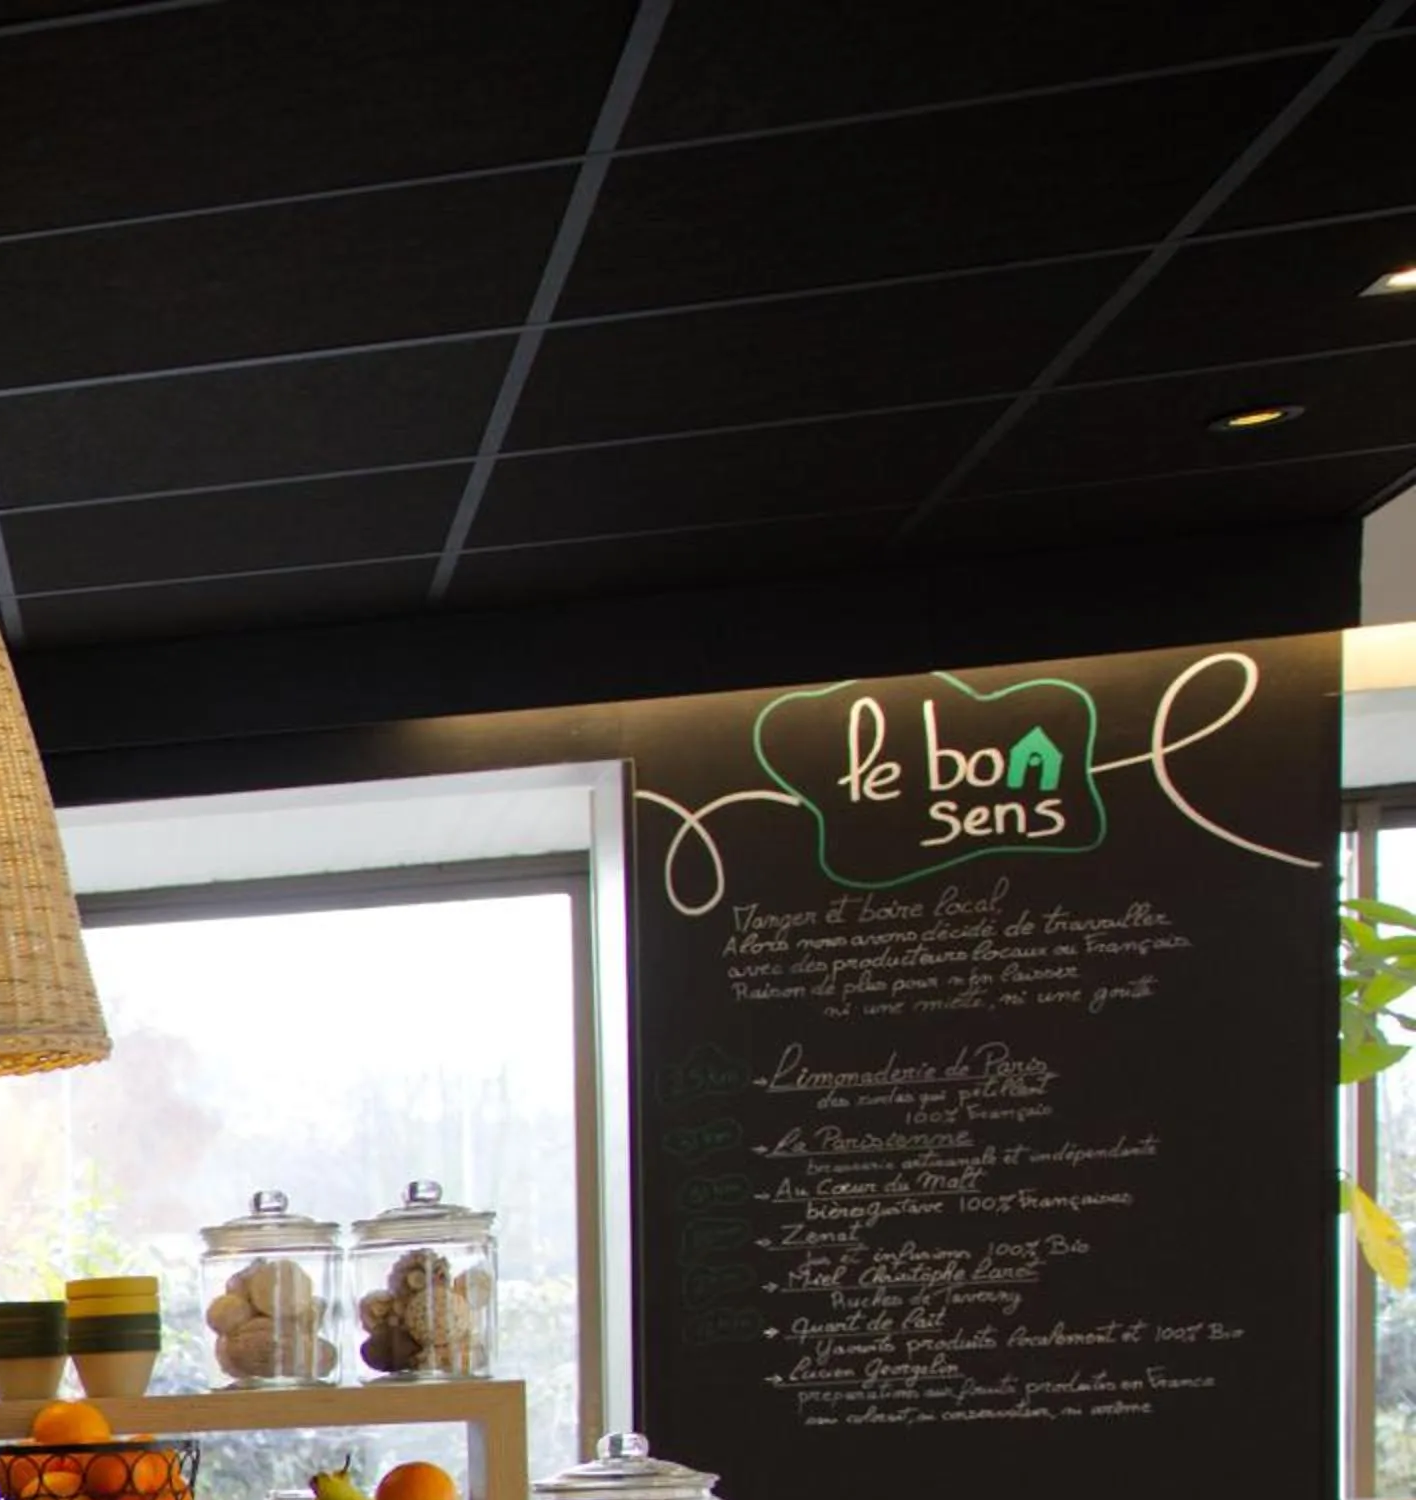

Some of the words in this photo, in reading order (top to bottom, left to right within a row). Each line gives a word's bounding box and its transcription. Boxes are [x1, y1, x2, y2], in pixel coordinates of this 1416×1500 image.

[837, 696, 901, 802] le
[919, 797, 1066, 847] sens
[1003, 909, 1036, 937] de
[943, 1045, 972, 1078] de
[1044, 1232, 1092, 1256] Bio
